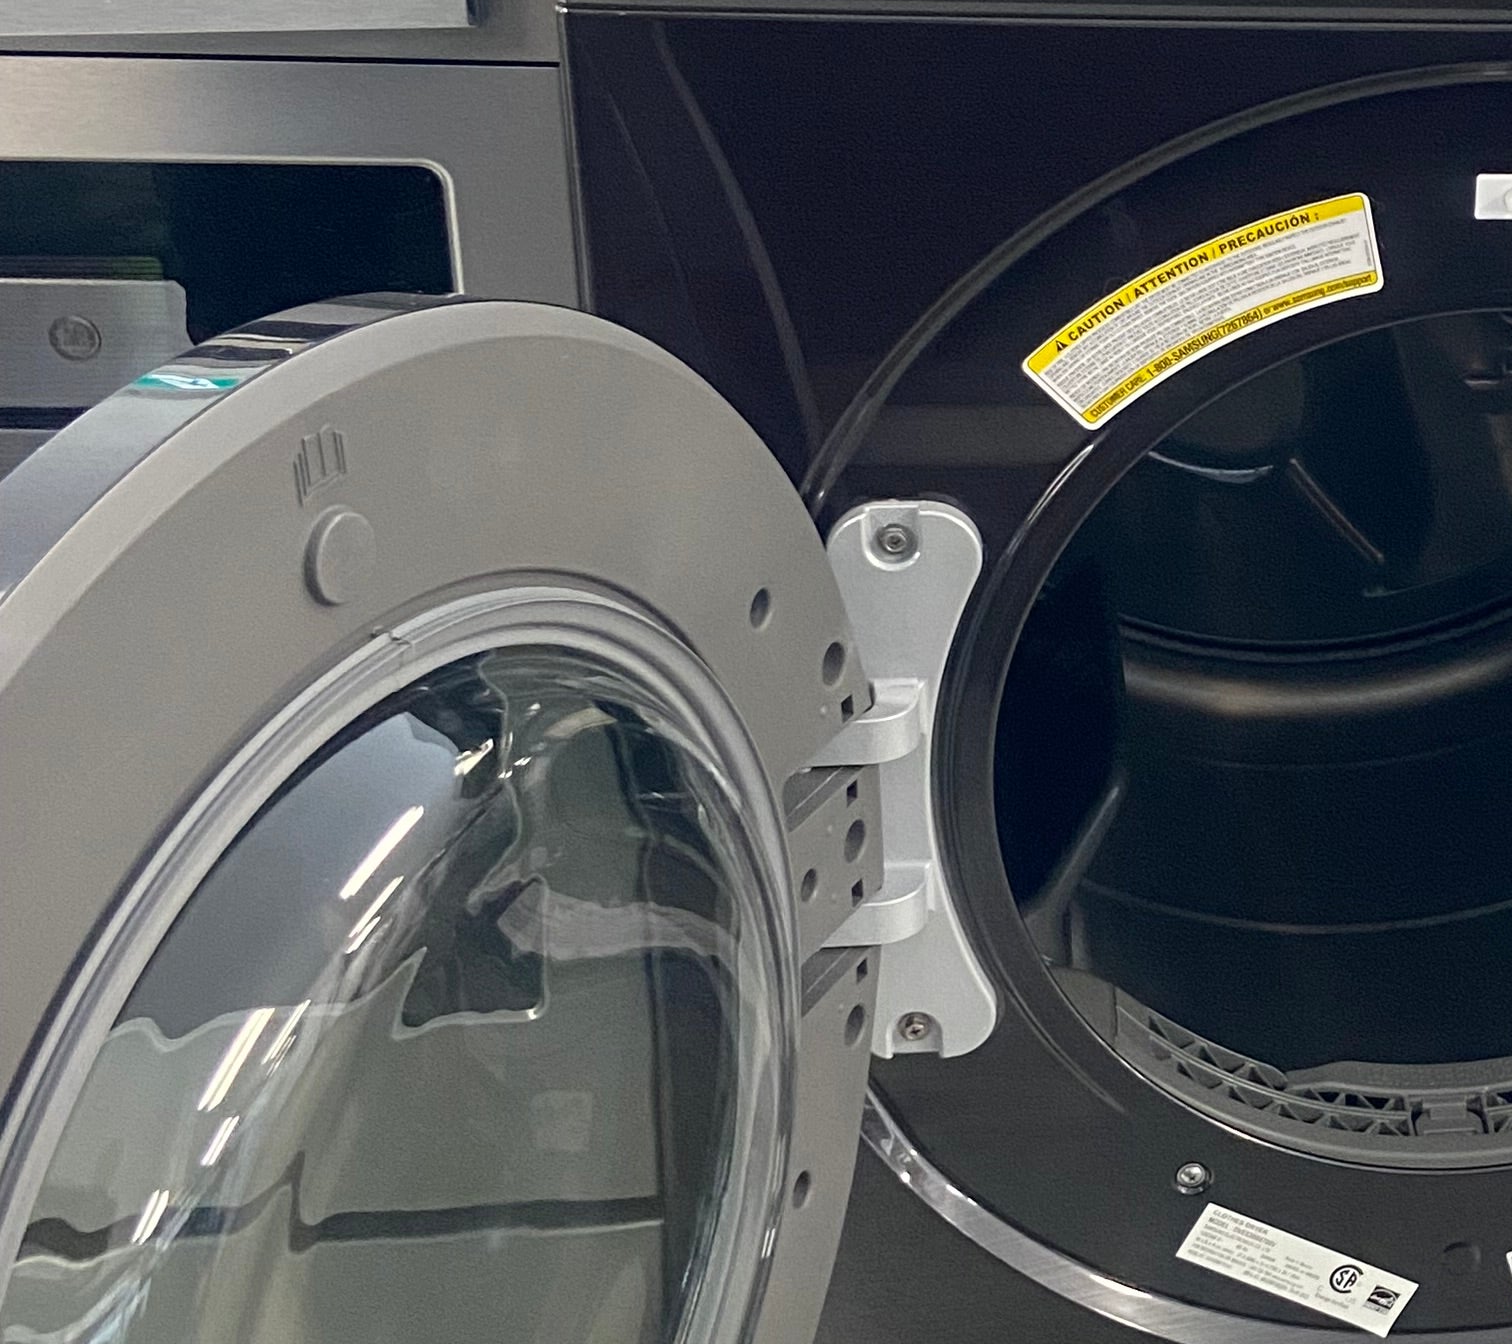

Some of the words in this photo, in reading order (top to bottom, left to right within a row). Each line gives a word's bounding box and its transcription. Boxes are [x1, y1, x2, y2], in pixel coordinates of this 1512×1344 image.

[1067, 298, 1126, 342] CAUTION
[1133, 251, 1210, 299] ATTENTION
[1089, 388, 1128, 418] CUSTOMER
